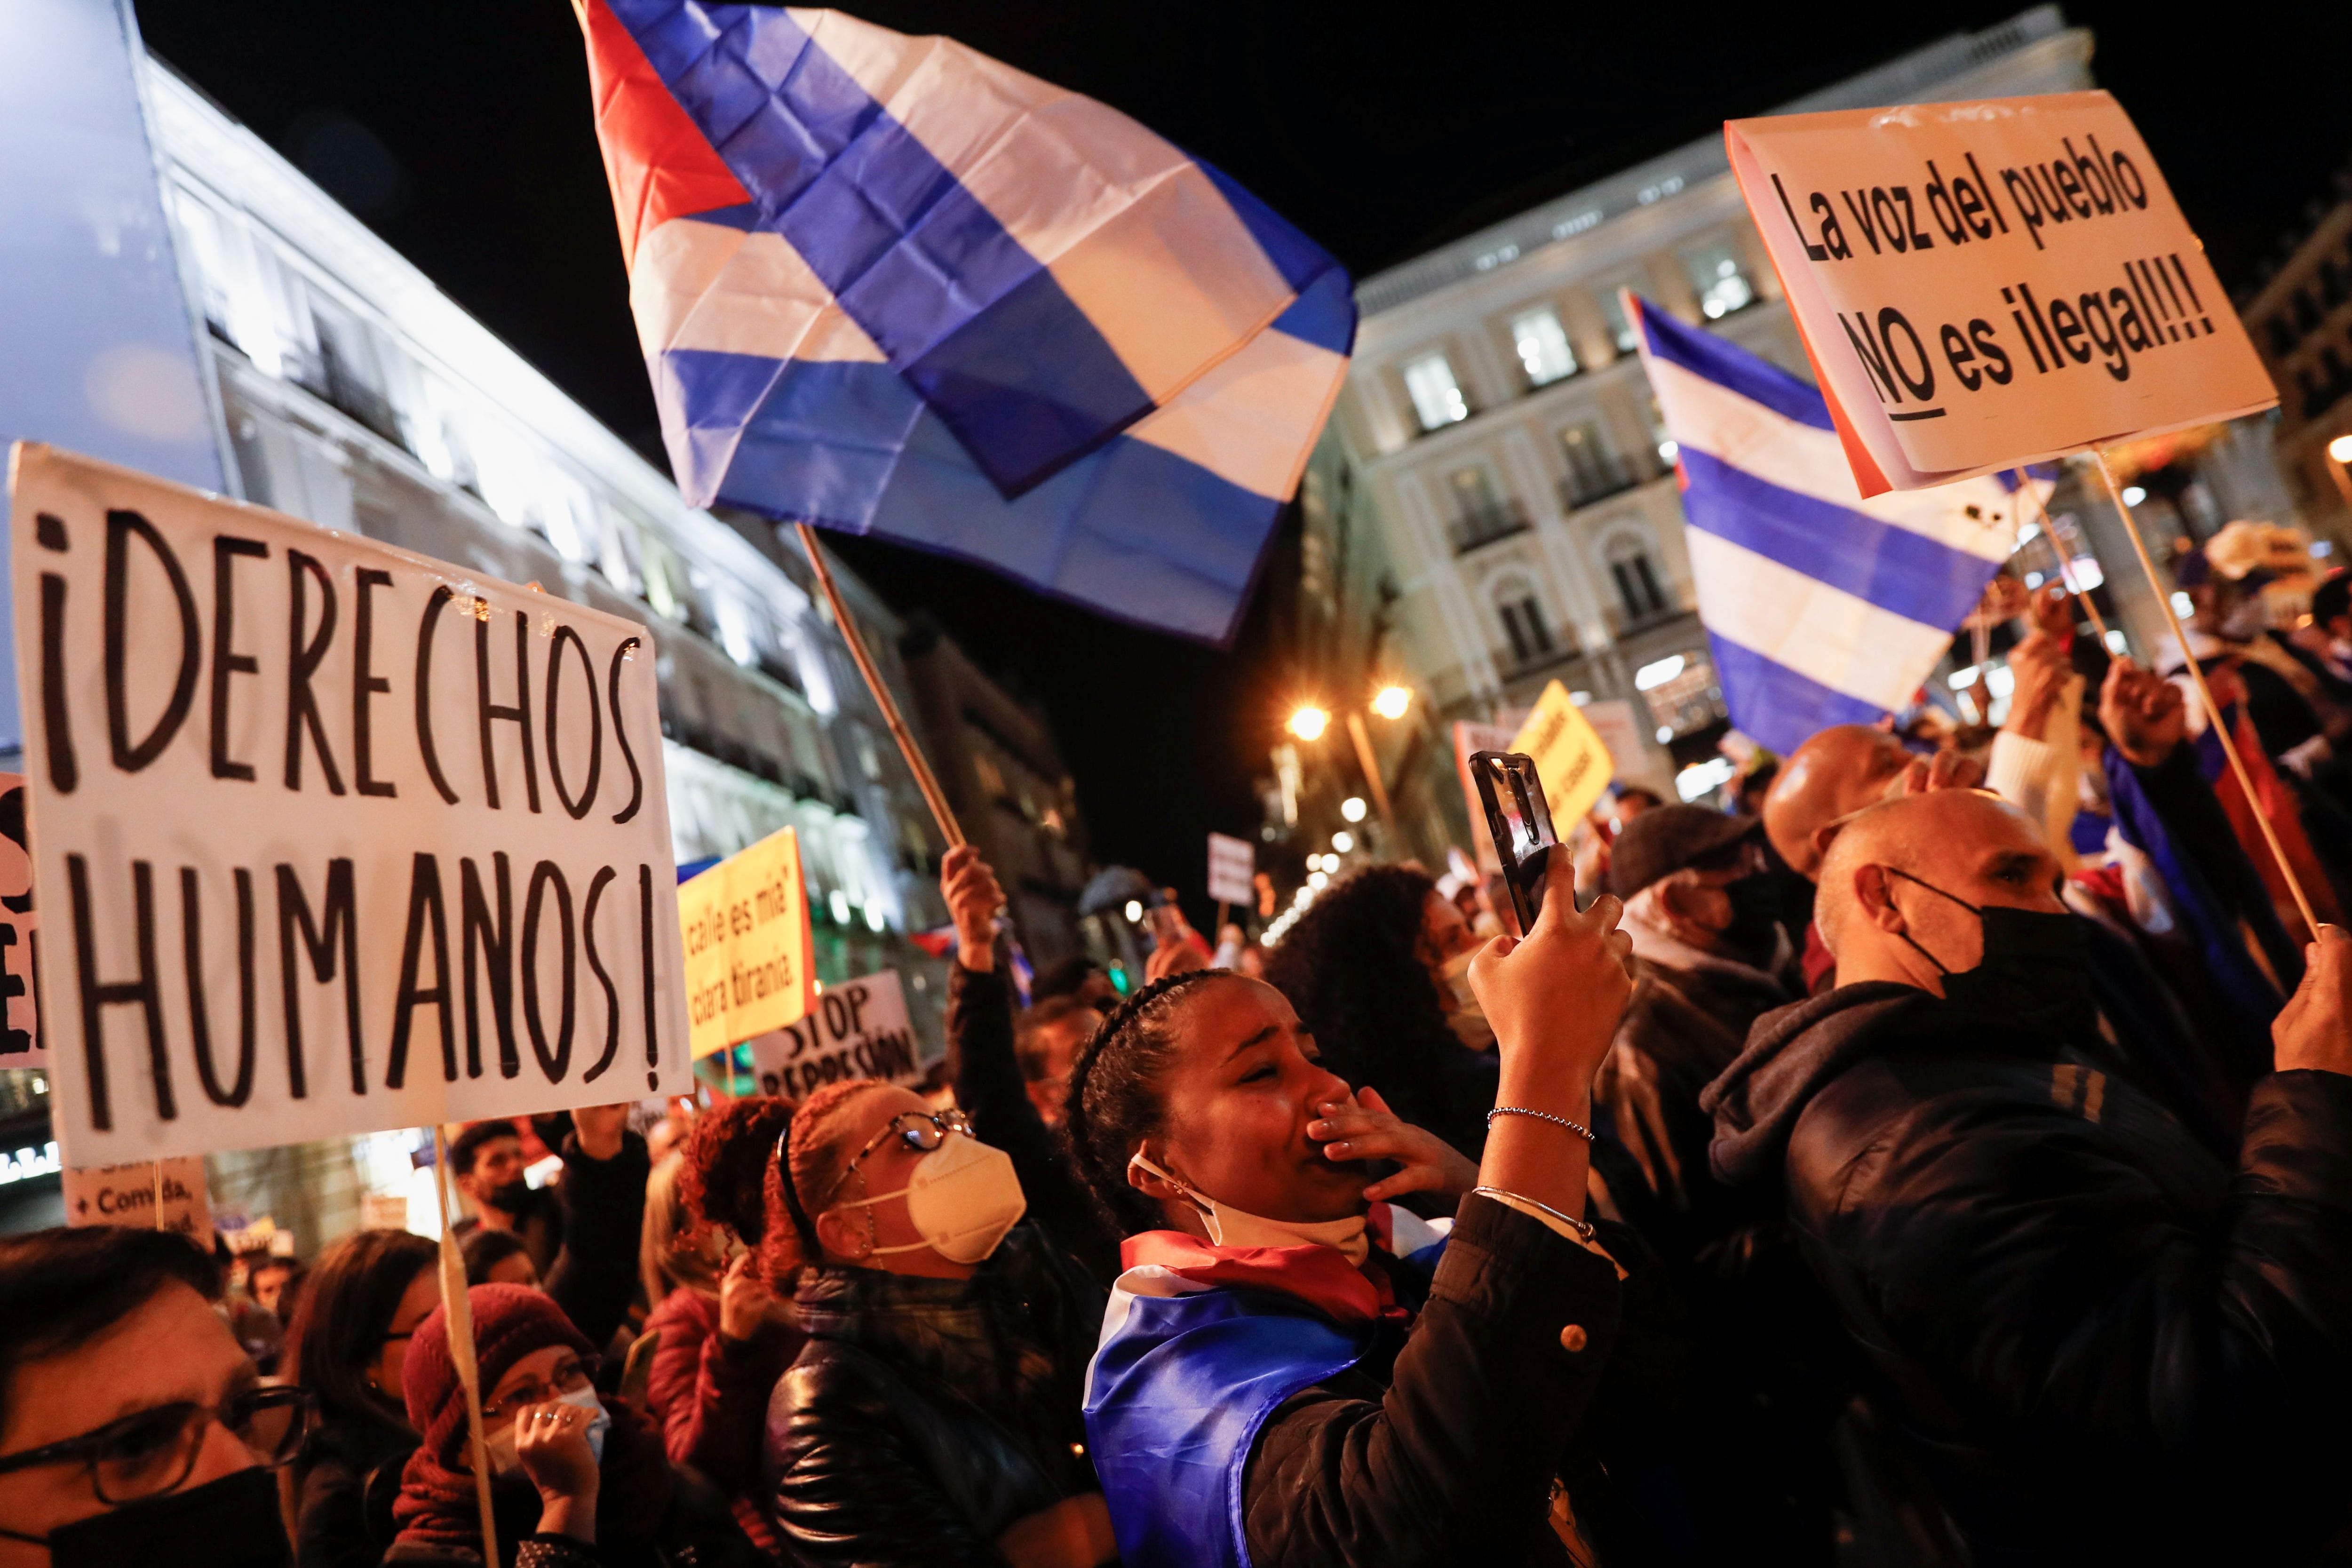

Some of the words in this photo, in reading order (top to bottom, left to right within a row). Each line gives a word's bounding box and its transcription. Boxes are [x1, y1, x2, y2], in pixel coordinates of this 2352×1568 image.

[1771, 173, 1853, 261] La
[1841, 186, 1935, 255] voz
[1925, 151, 2009, 246] del
[1999, 134, 2148, 250] pueblo
[1837, 306, 1935, 403] NO
[1940, 318, 2013, 392] es
[2001, 253, 2215, 382] ilegal!!!
[35, 509, 642, 825] ¡DERECHOS
[64, 851, 659, 1131] HUMANOS!
[687, 902, 725, 955] calle
[730, 899, 753, 937] es
[97, 1176, 192, 1215] Comda,
